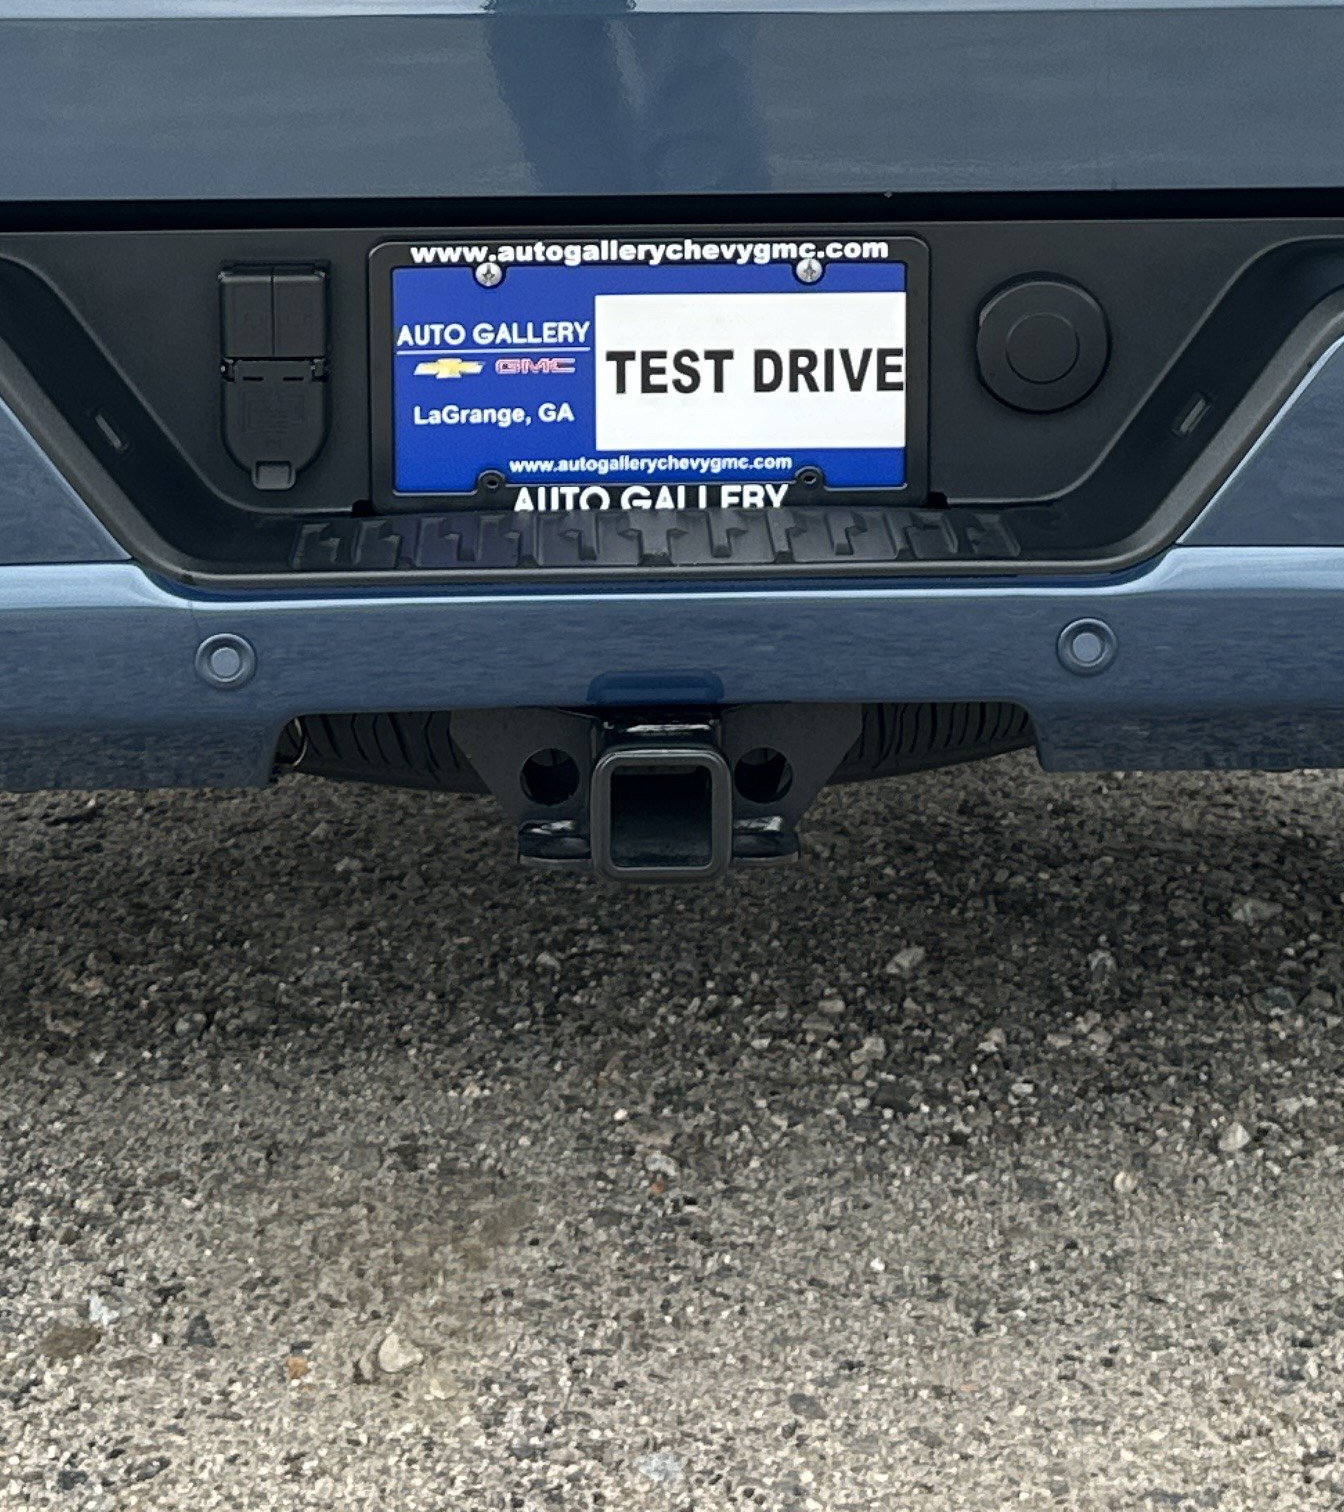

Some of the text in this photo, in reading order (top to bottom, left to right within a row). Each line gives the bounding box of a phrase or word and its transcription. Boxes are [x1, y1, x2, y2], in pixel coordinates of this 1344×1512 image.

[410, 240, 889, 267] www.autogallerychevygmc.com
[396, 321, 590, 347] AUTO GALLERY
[495, 357, 576, 375] GMC
[605, 347, 904, 394] TEST DRIVE
[413, 402, 575, 427] LaGrange, GA
[509, 456, 793, 475] www.autogallerychevygmc.com
[513, 484, 789, 511] AUTO GALLERY
